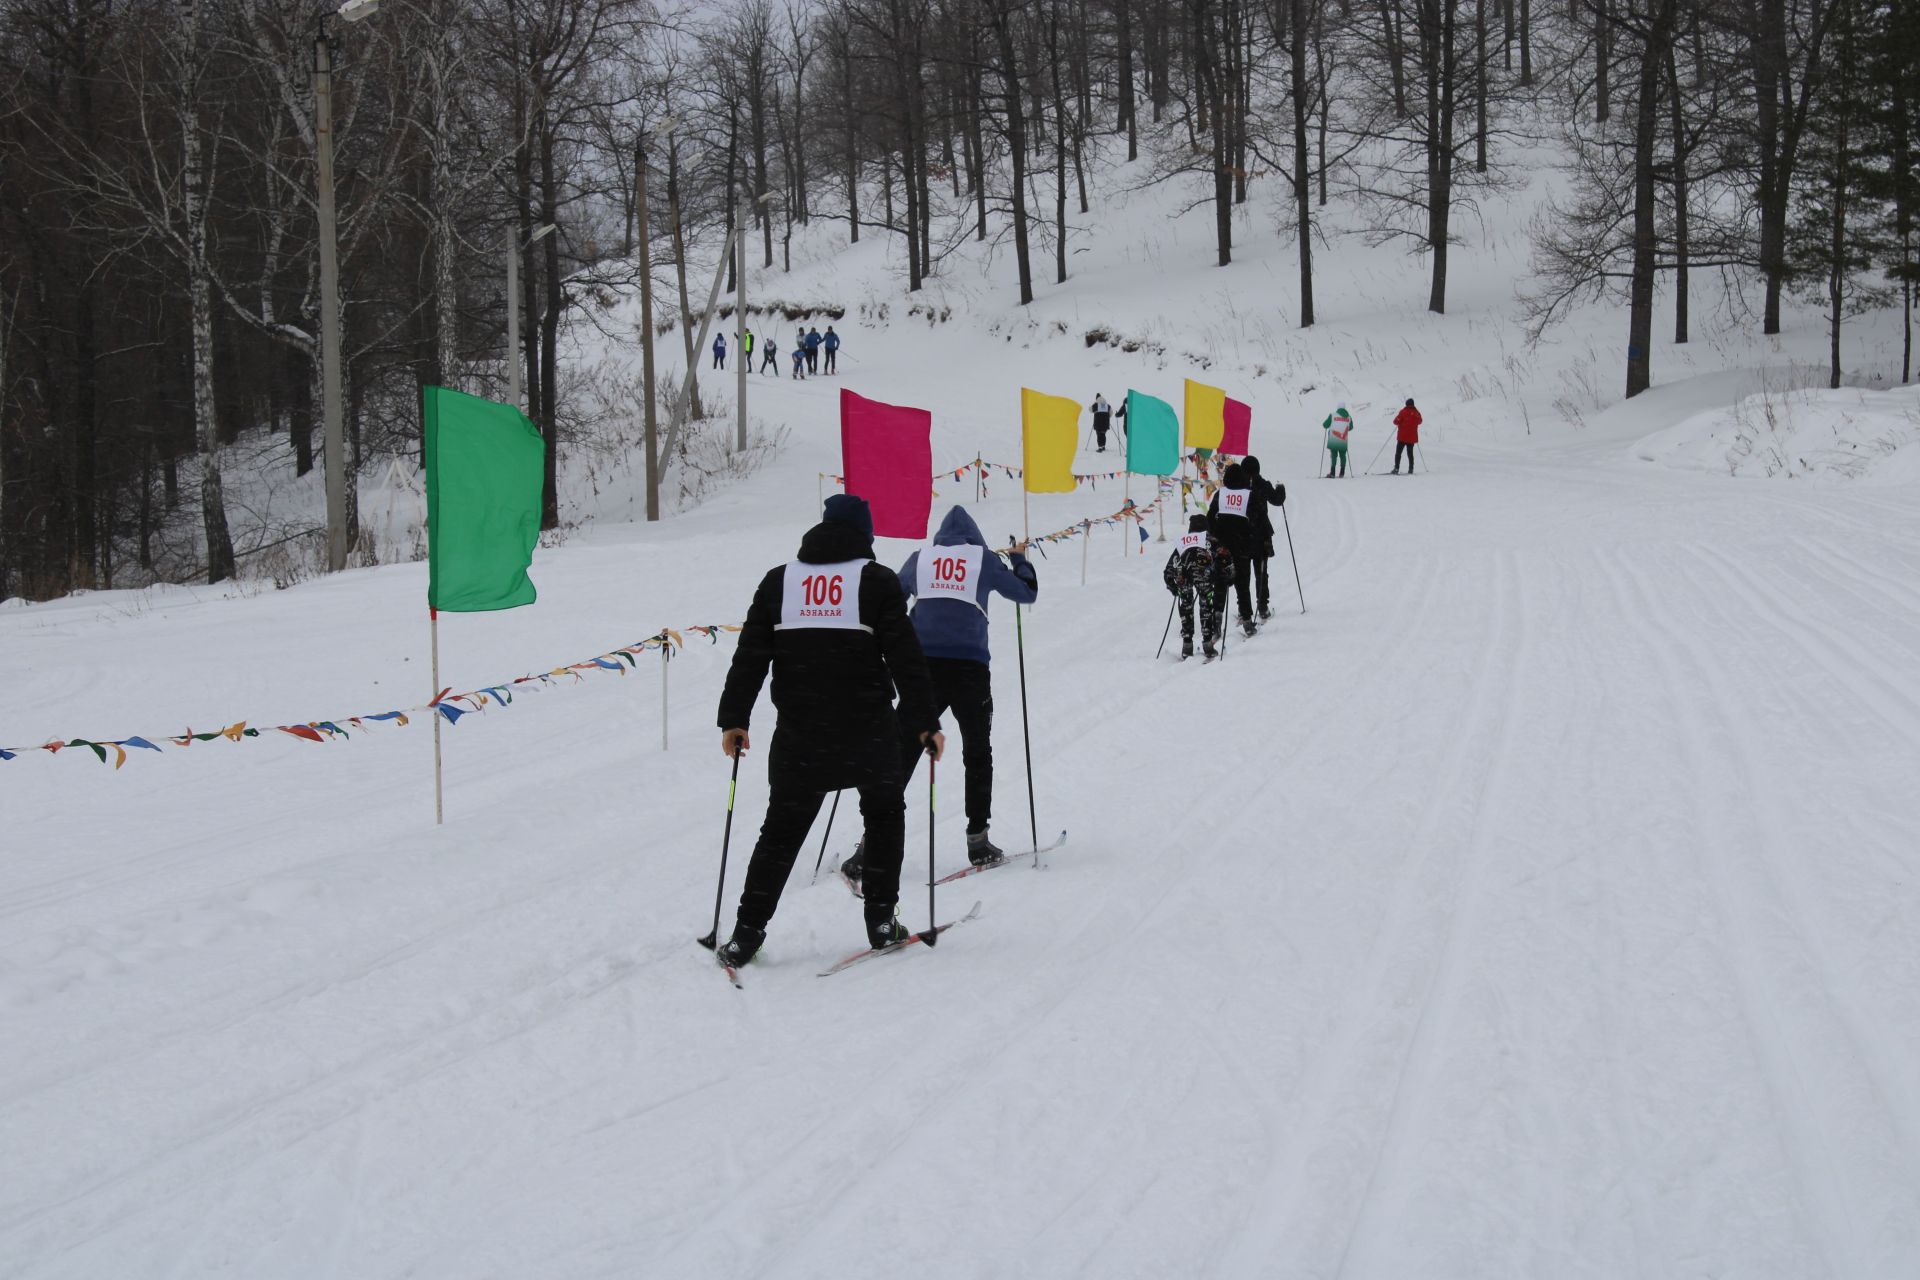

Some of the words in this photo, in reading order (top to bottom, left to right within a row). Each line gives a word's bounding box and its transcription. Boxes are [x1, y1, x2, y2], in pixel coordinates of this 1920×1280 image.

[1226, 494, 1242, 506] 109
[1181, 535, 1198, 544] 104
[932, 558, 966, 582] 105
[801, 575, 843, 606] 106
[800, 608, 842, 616] АЗНАКАЙ
